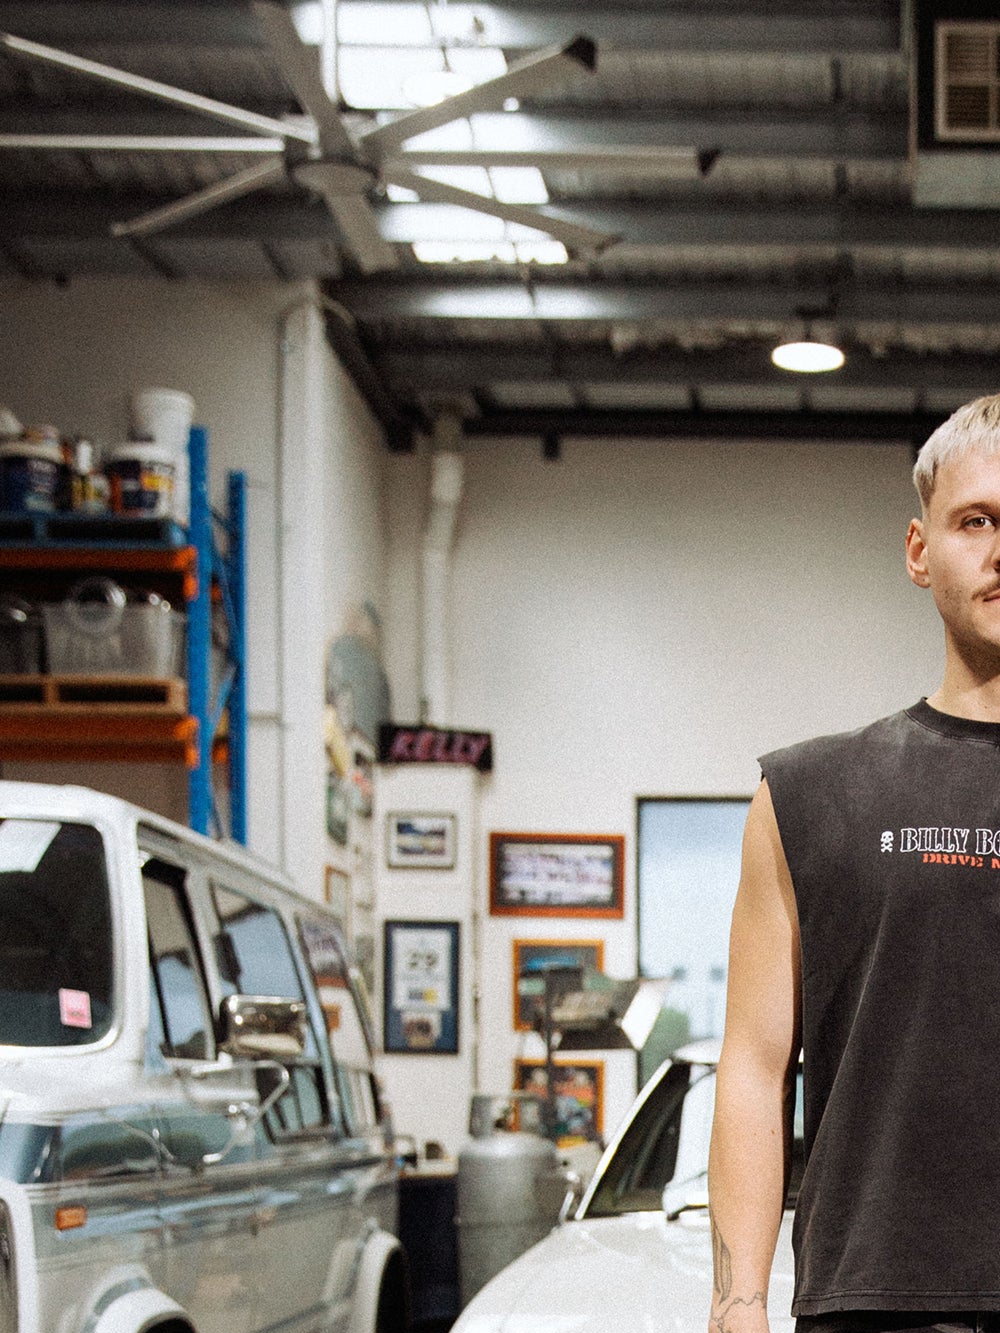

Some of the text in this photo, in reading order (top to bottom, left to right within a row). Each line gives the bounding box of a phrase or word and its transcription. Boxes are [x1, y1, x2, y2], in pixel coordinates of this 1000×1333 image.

[391, 730, 490, 763] KELLY
[900, 827, 970, 853] BILLY
[922, 853, 984, 868] DRIVE
